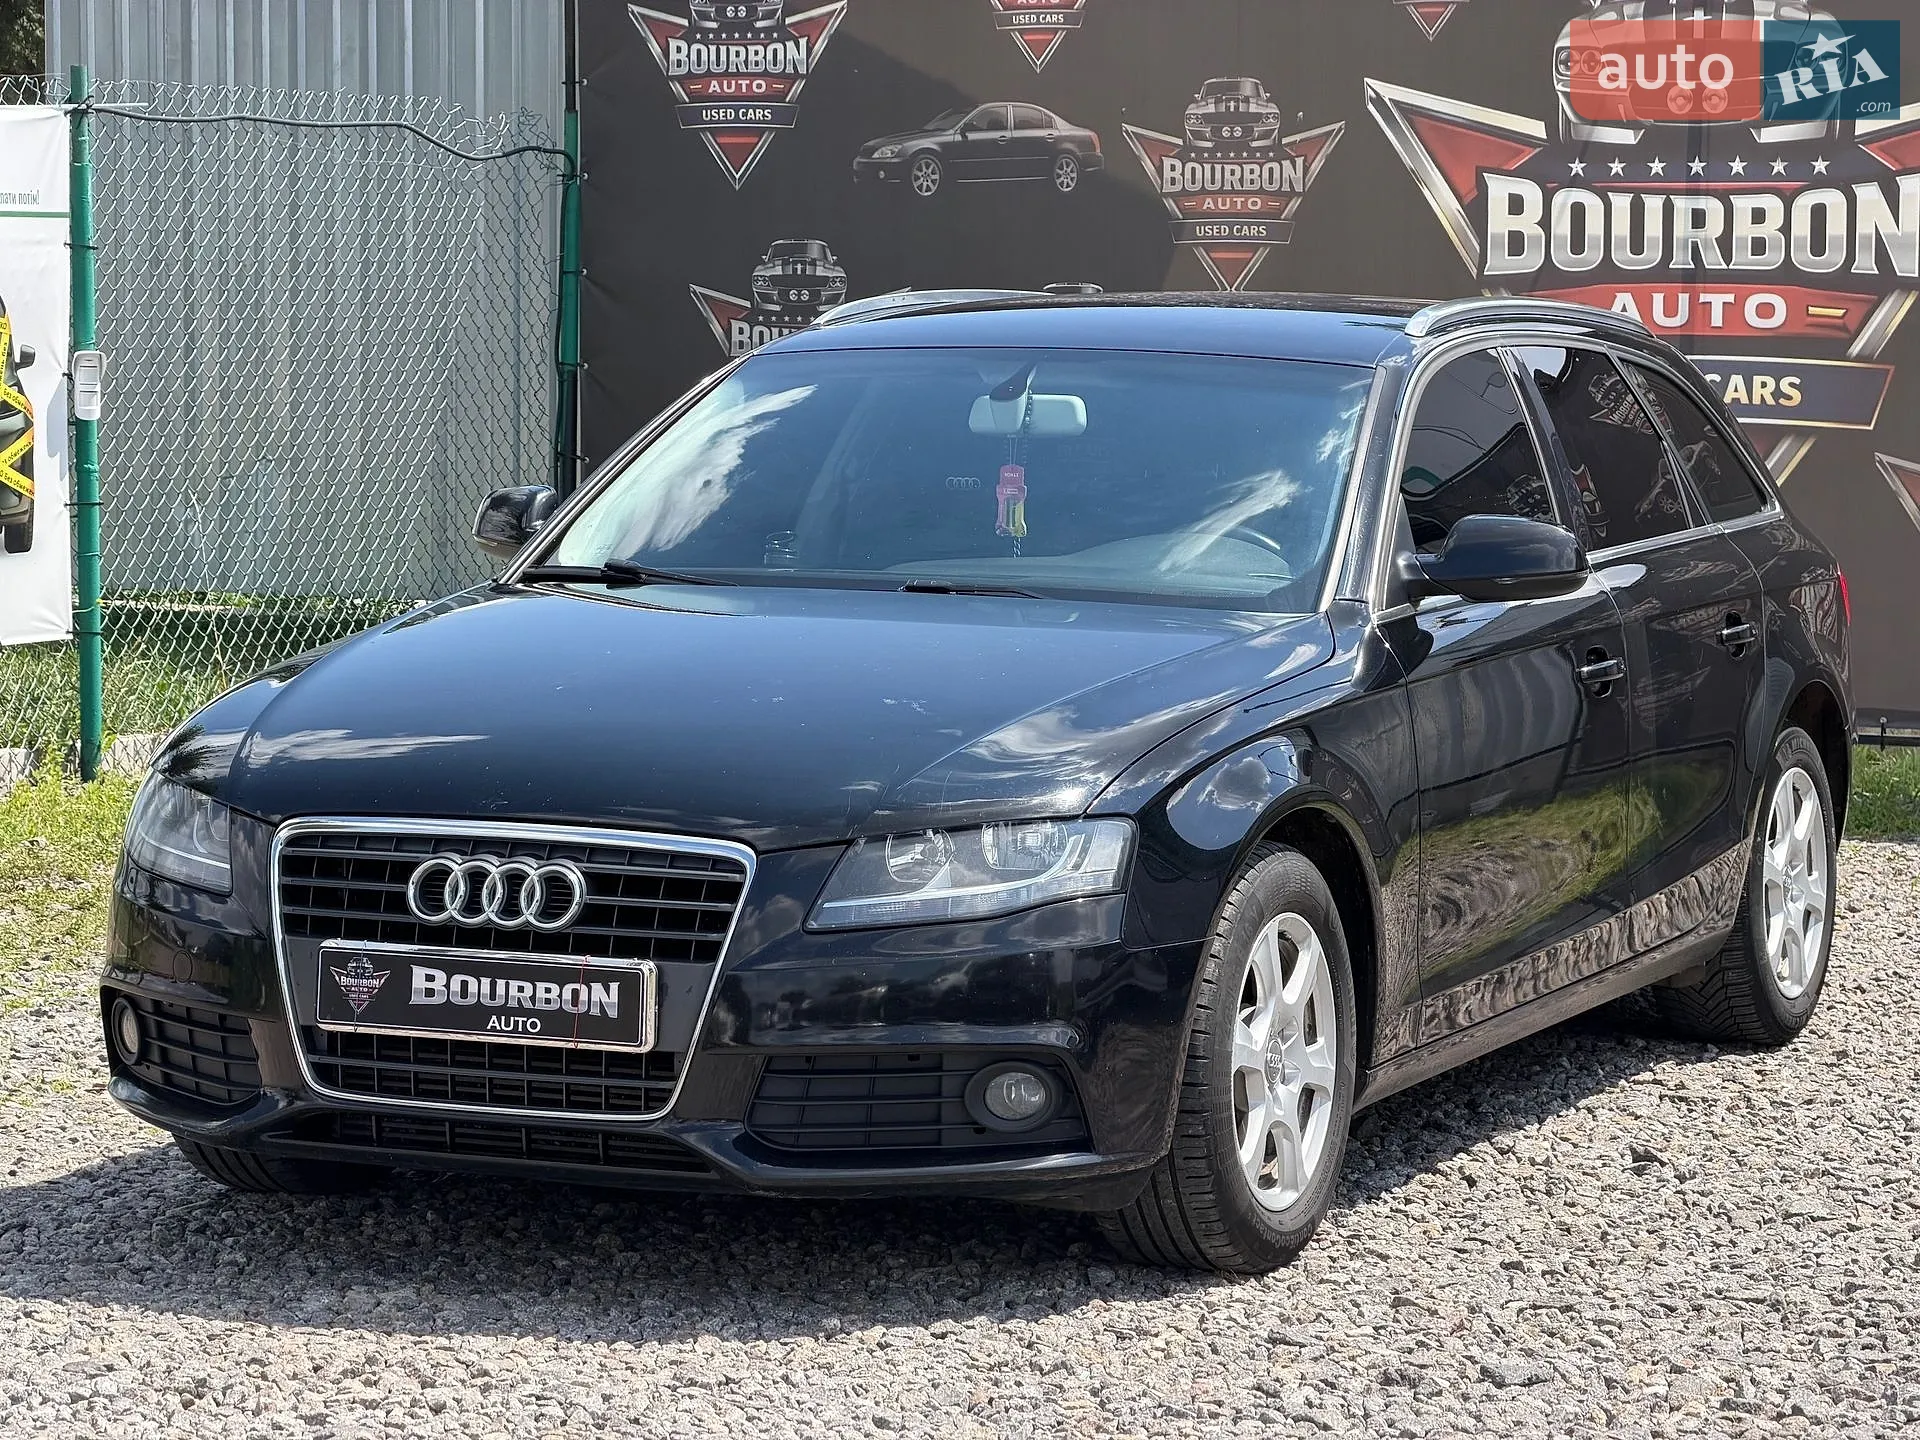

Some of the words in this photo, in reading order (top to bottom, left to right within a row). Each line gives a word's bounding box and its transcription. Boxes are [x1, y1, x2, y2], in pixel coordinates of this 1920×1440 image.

[1012, 14, 1037, 24] USED
[1039, 14, 1064, 23] CARS
[668, 37, 809, 76] BOURBON
[708, 80, 767, 93] AUTO
[702, 109, 735, 121] USED
[738, 109, 772, 121] CARS
[1161, 156, 1305, 193] BOURBON
[1202, 198, 1262, 210] AUTO
[1195, 225, 1229, 237] USED
[1233, 225, 1267, 237] CARS
[1482, 172, 1920, 278] BOURBON
[340, 976, 380, 988] BOURBON
[409, 964, 621, 1018] BOURBON
[486, 1015, 542, 1033] AUTO
